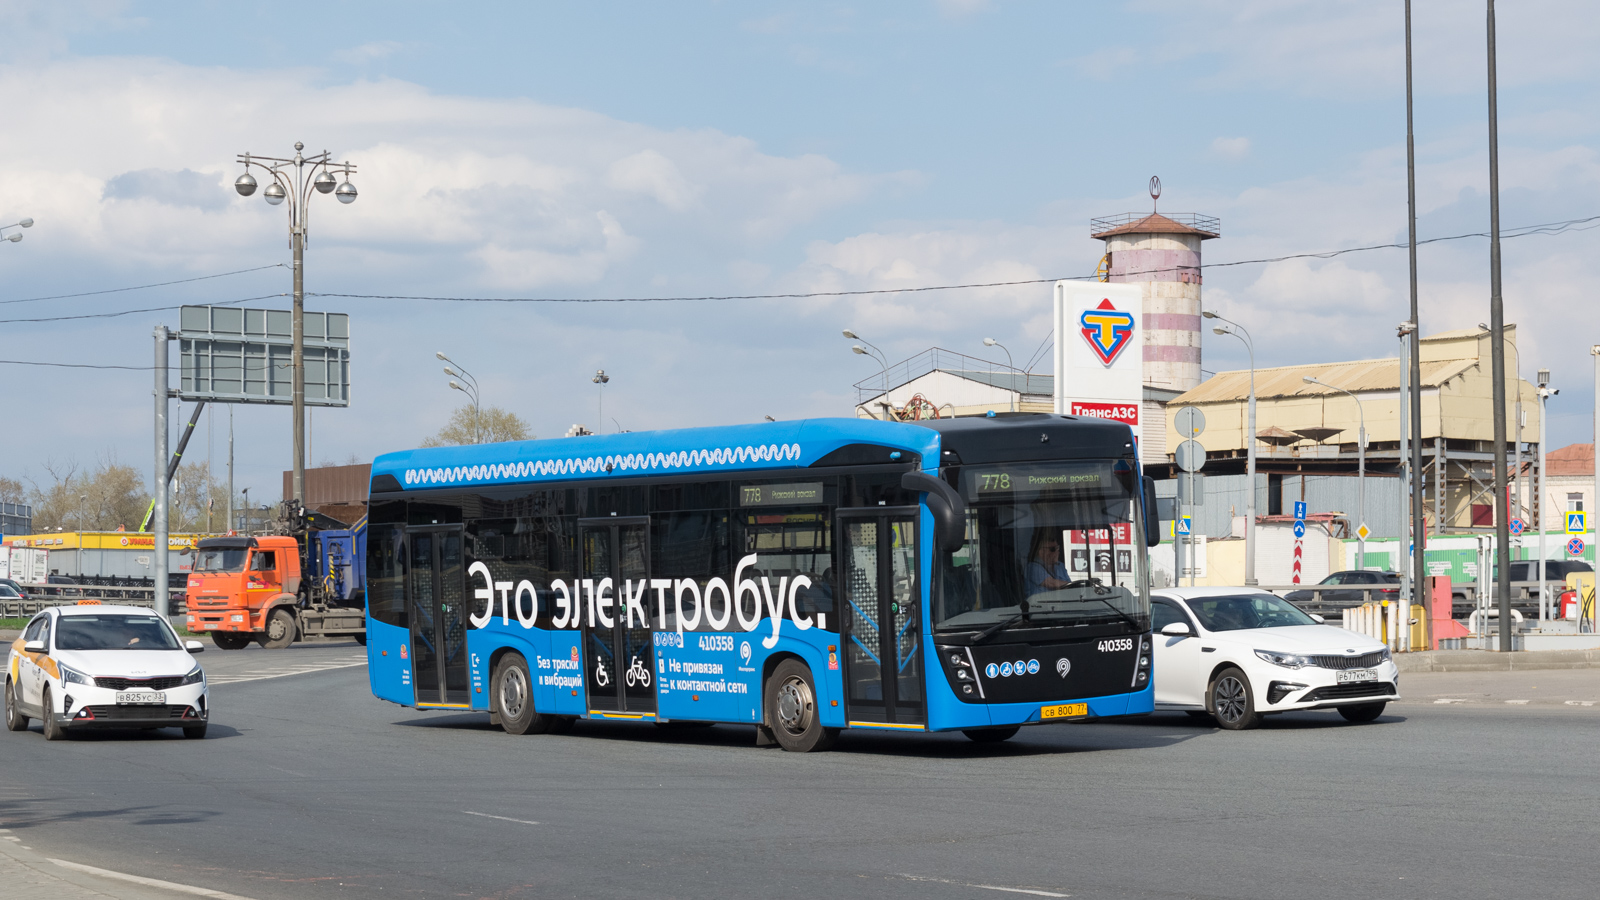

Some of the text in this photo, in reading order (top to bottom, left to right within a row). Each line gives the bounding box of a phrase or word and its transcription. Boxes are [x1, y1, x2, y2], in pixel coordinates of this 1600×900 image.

[1073, 405, 1136, 419] ТрансАЗС
[981, 473, 1099, 490] 778 Рижский вокзал
[743, 488, 761, 502] 778
[128, 538, 155, 546] УМНА
[168, 537, 192, 546] ОЙКА
[467, 552, 826, 649] Это электробус.
[698, 635, 734, 651] 410358
[1097, 638, 1133, 652] 410358
[537, 655, 578, 672] Без тряски
[669, 658, 723, 676] Не привязан
[539, 673, 582, 689] и вибраций
[670, 679, 747, 694] к контактной сети
[1045, 709, 1055, 717] СВ
[1058, 706, 1073, 715] 800
[1077, 704, 1085, 712] 77
